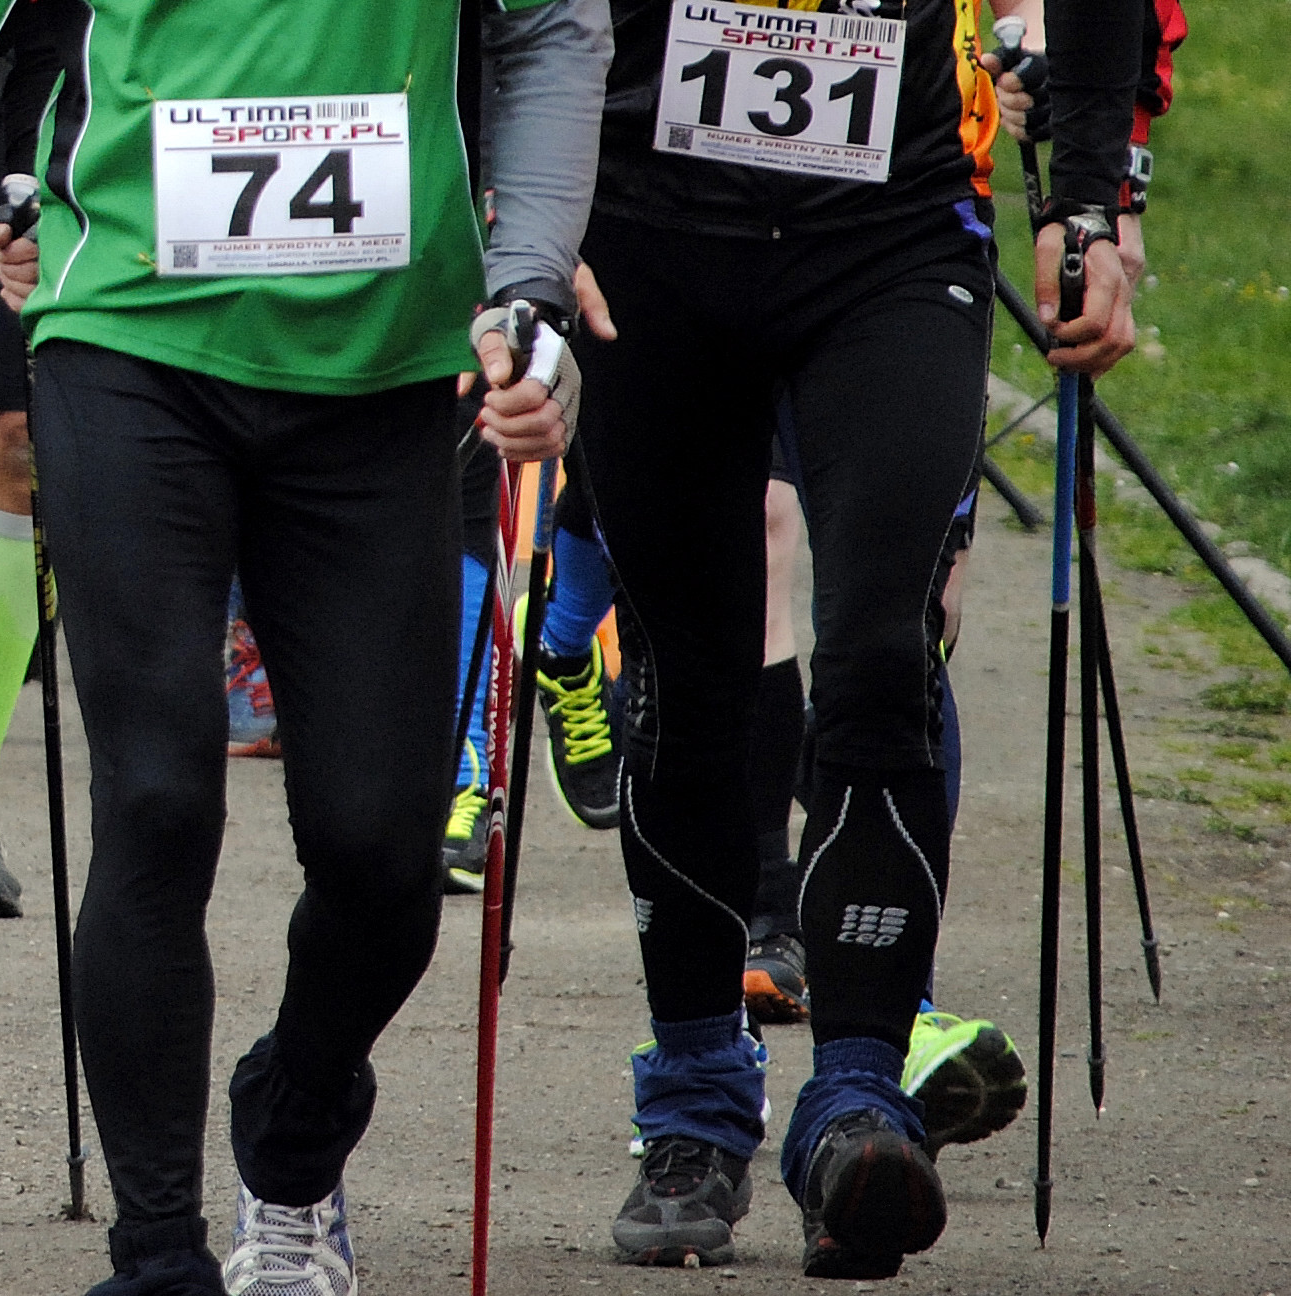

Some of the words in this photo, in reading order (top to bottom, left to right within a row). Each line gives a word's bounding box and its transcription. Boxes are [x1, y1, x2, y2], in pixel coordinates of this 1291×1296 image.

[684, 4, 818, 35] ULTIMA
[721, 27, 896, 61] SPORT.PL
[680, 48, 880, 146] 131
[170, 104, 313, 124] ULTIMA
[212, 121, 401, 144] SPORT.PL
[707, 132, 752, 145] NUMER
[756, 139, 818, 153] ZWROTNY
[821, 148, 839, 156] NA
[211, 148, 365, 238] 74
[213, 242, 262, 252] NUMER
[266, 240, 332, 251] ZWROTNY
[337, 239, 355, 248] NA
